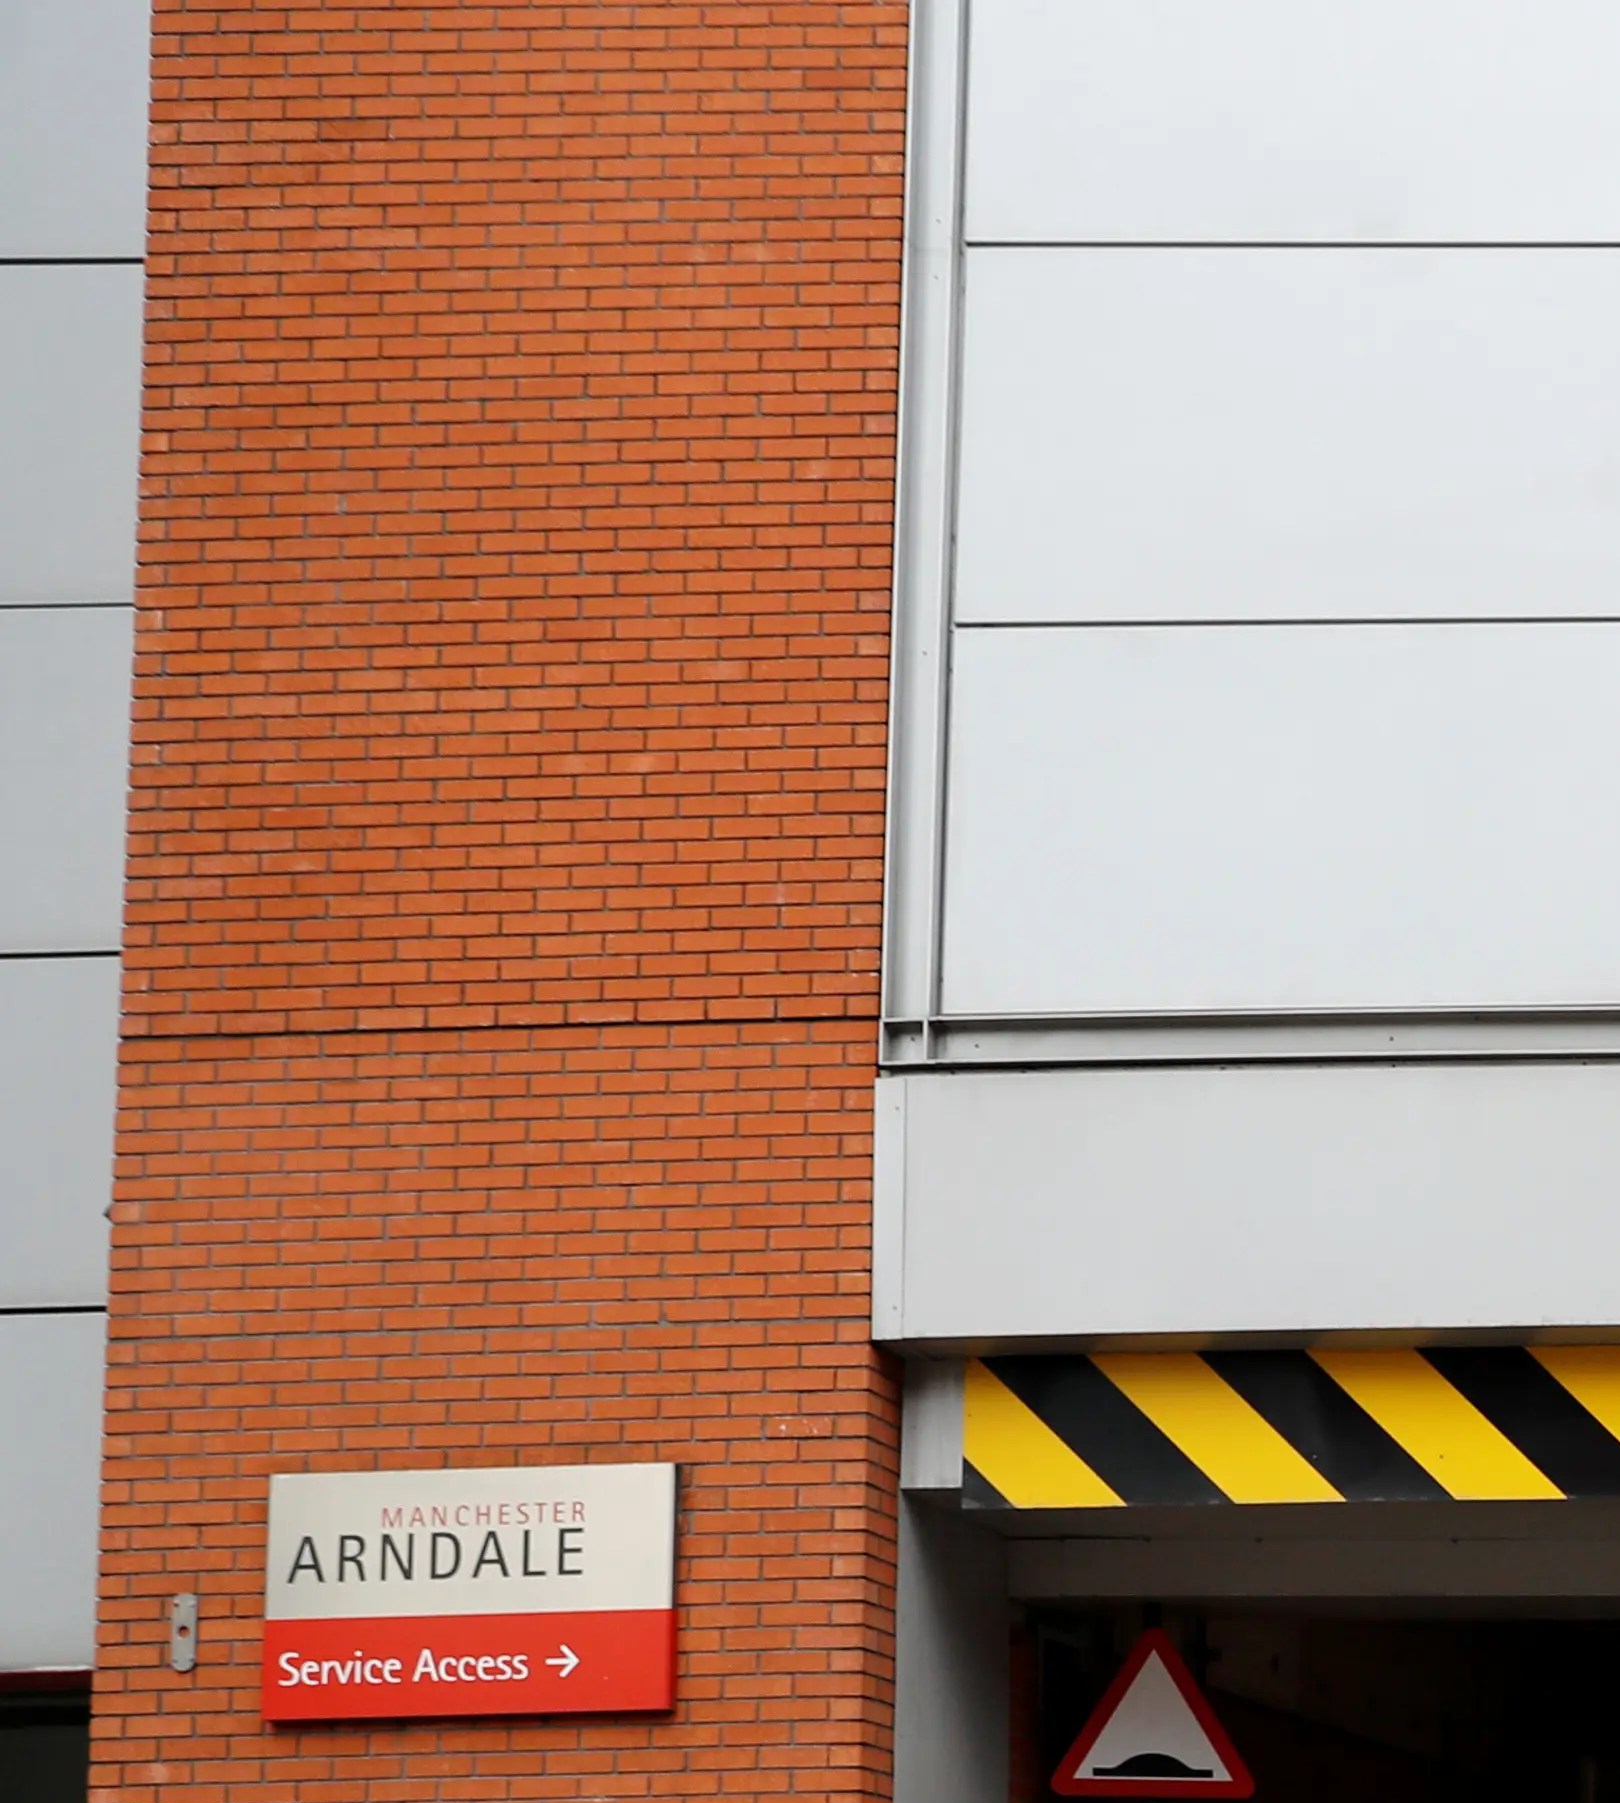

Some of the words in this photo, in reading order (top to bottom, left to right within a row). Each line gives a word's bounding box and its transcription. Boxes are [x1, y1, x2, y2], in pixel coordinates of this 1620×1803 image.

[381, 1502, 586, 1528] MANCHESTER
[288, 1527, 585, 1584] ARNDALE
[277, 1650, 402, 1687] Service
[412, 1648, 530, 1682] Access
